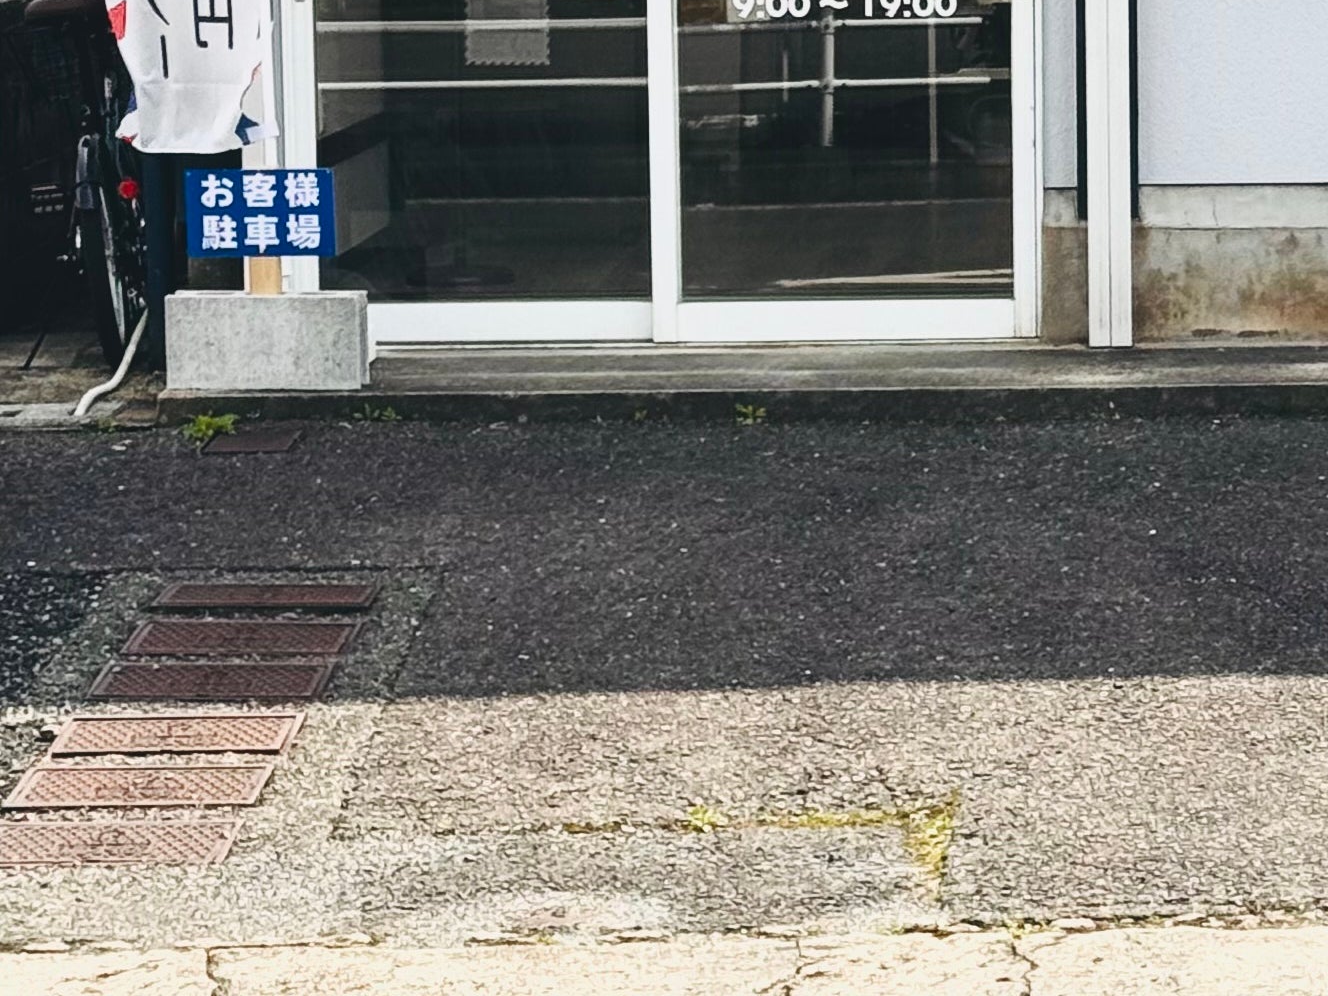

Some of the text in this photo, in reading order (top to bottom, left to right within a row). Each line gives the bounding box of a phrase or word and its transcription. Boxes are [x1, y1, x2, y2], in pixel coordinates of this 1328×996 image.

[200, 172, 320, 208] お客様
[201, 213, 321, 254] 駐車場
